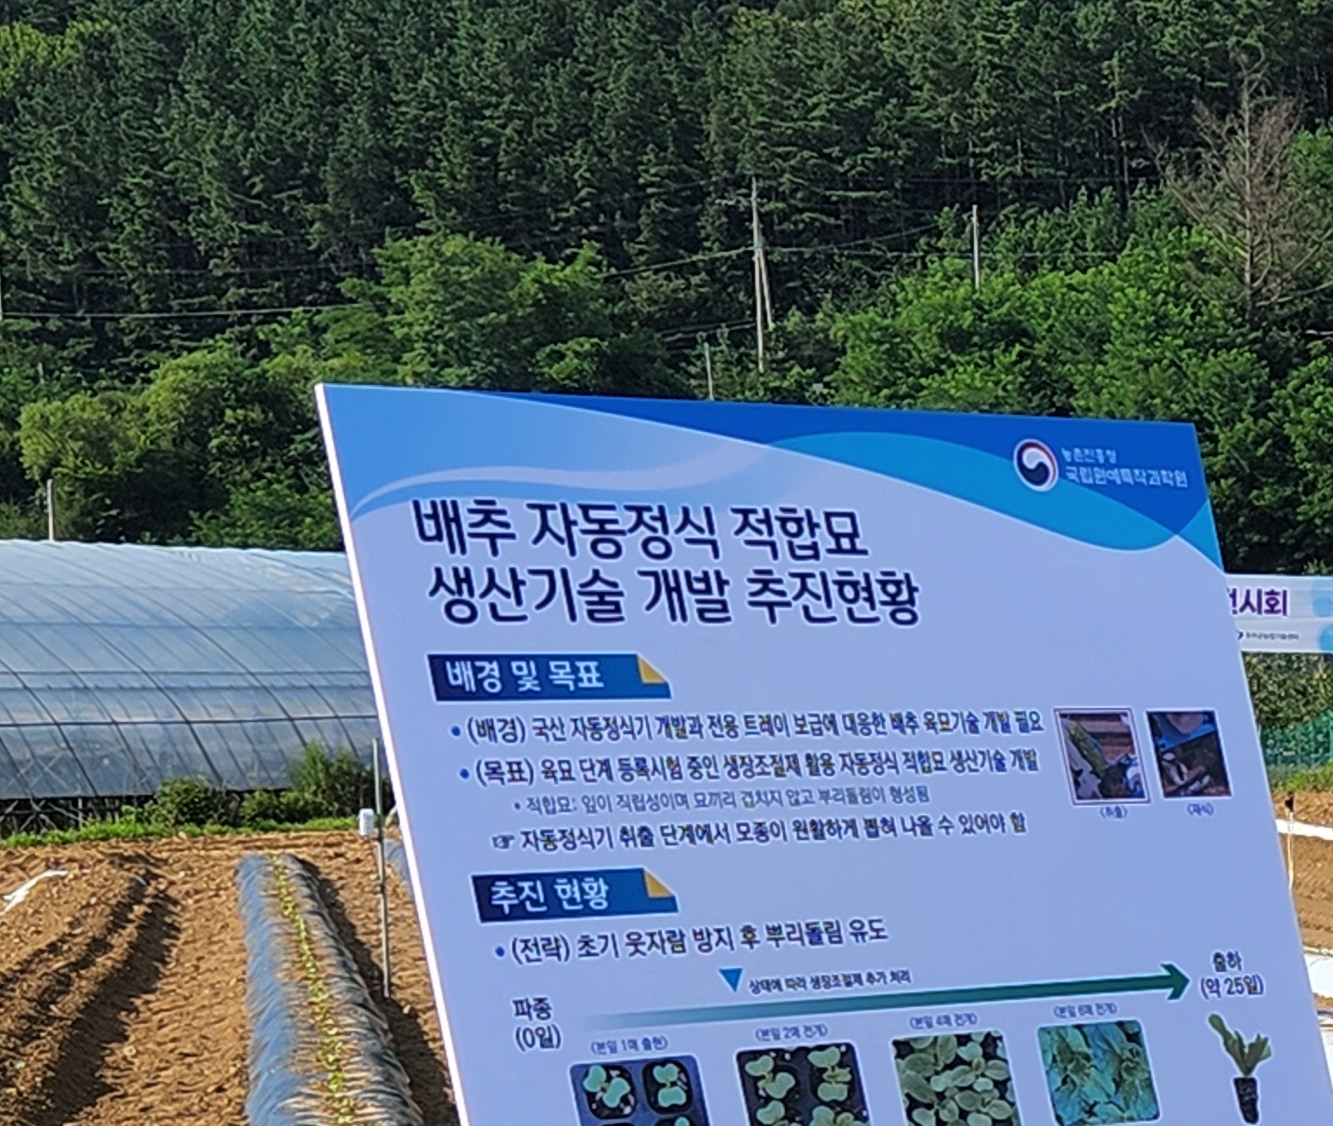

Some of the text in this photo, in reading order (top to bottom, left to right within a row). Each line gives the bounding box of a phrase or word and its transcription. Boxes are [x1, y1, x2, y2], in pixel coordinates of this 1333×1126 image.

[411, 498, 869, 561] 배추 자동정식 적합묘
[428, 565, 920, 626] 생산기술 개발 추진현황
[445, 659, 604, 693] 배경 및 목표
[467, 711, 1044, 745] (배경) 국산 자동정식기 개발과 전용 트레이 보급에 대응한 배추 육묘기술 개발 필요
[476, 750, 1039, 787] (목표) 육묘 단계 등록시험 중인 생장조절제 활용 자동정식 적합묘 생산기술 개발
[521, 829, 613, 852] 자동정식기
[659, 823, 730, 847] 단계에서
[736, 820, 787, 844] 모종이
[793, 818, 859, 842] 원활하게
[938, 815, 954, 837] 수
[958, 813, 1006, 836] 있어야
[1010, 812, 1027, 834] 함
[490, 877, 610, 916] 추진 현황
[511, 934, 571, 967] (전략)
[578, 932, 620, 960] 초기
[624, 928, 687, 958] 웃자람
[693, 926, 735, 954] 방지
[740, 925, 761, 950] 후
[849, 918, 889, 944] 유도
[1224, 974, 1265, 997] 25일)
[513, 997, 552, 1021] 파종
[514, 1023, 562, 1052] (0일)
